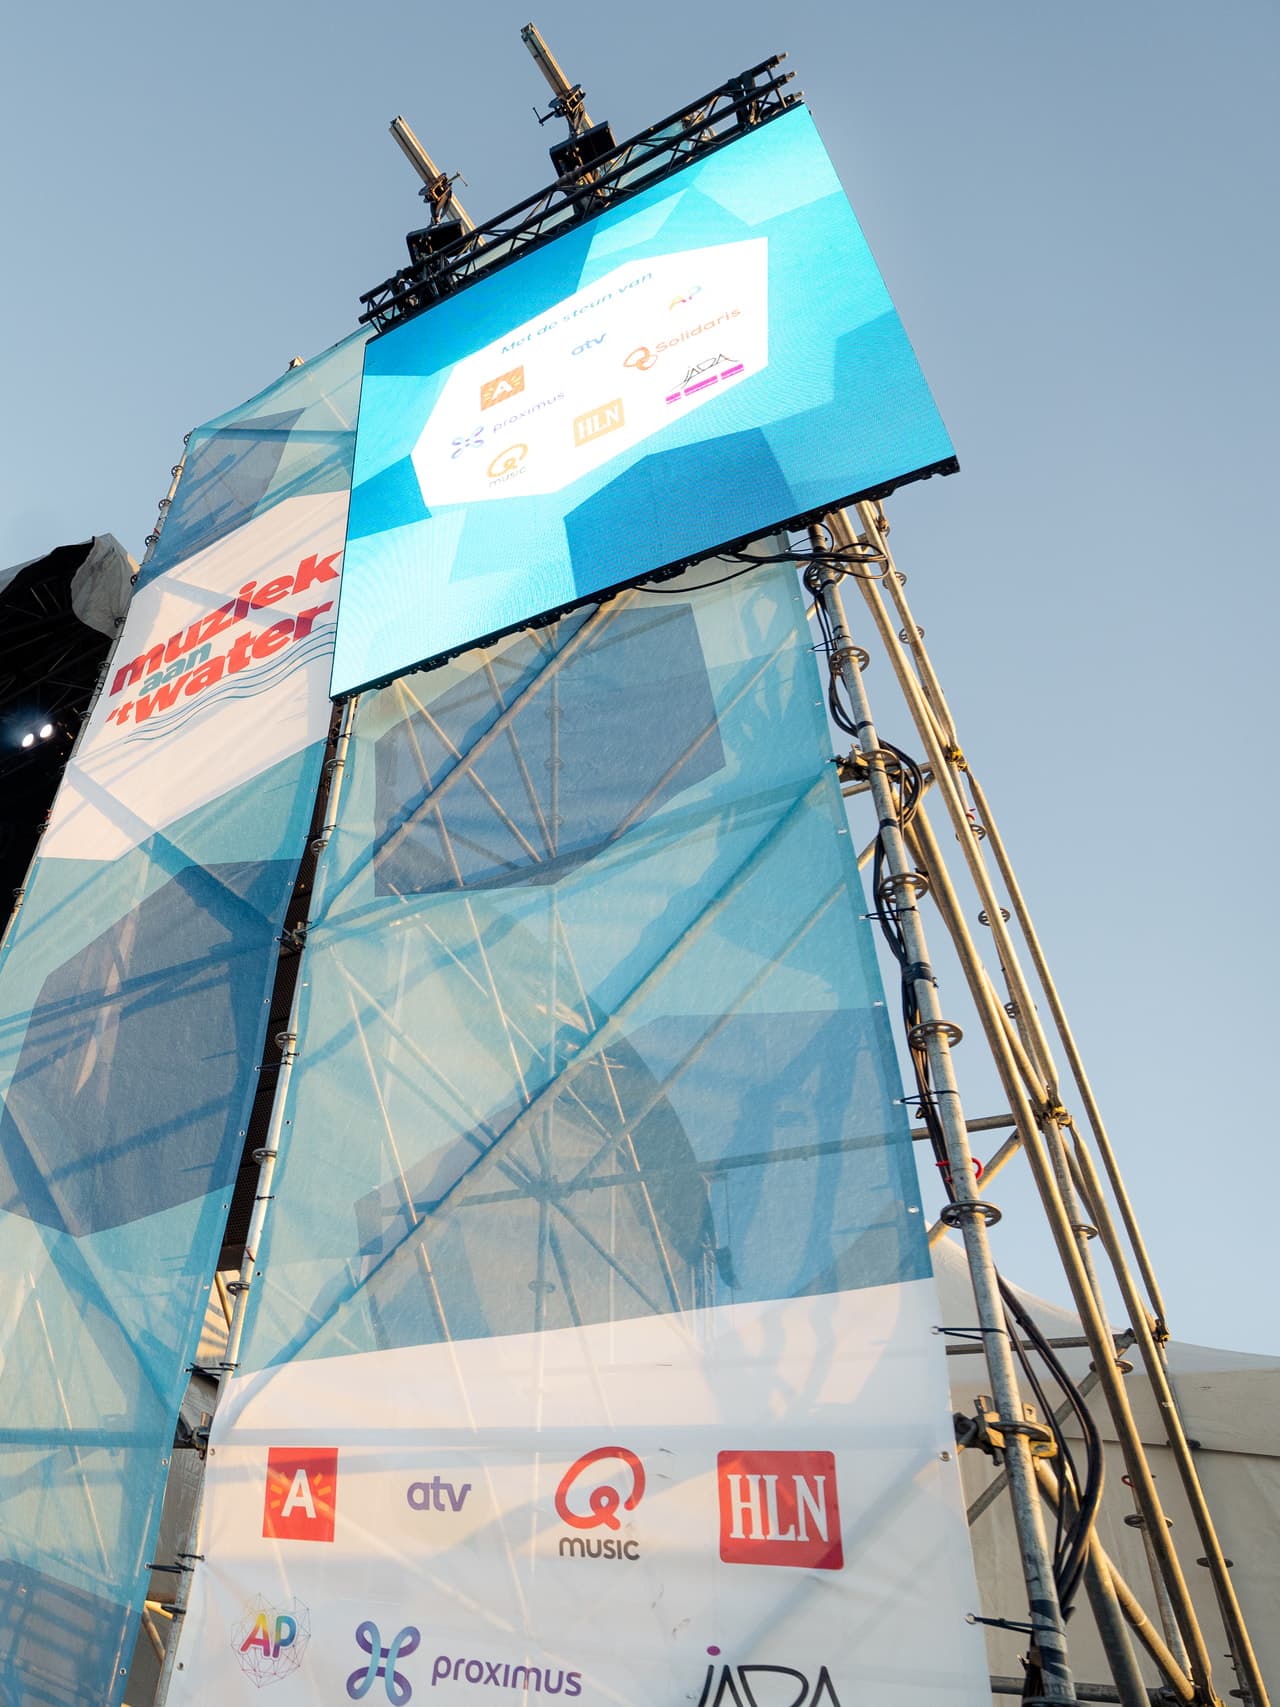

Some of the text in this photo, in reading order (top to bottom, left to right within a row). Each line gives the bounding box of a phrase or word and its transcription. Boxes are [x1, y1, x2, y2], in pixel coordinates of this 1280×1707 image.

[501, 272, 653, 355] Met de steun van
[656, 308, 742, 352] Solidaris
[570, 332, 609, 358] atv
[493, 392, 565, 433] proximus
[578, 405, 619, 440] HLN
[489, 466, 526, 488] music
[109, 550, 344, 697] muziek
[139, 642, 213, 697] aan
[280, 1468, 317, 1519] A
[406, 1475, 472, 1512] atv
[727, 1474, 829, 1542] HLN
[559, 1536, 640, 1561] music
[239, 1612, 297, 1659] AP
[431, 1655, 583, 1697] proximus
